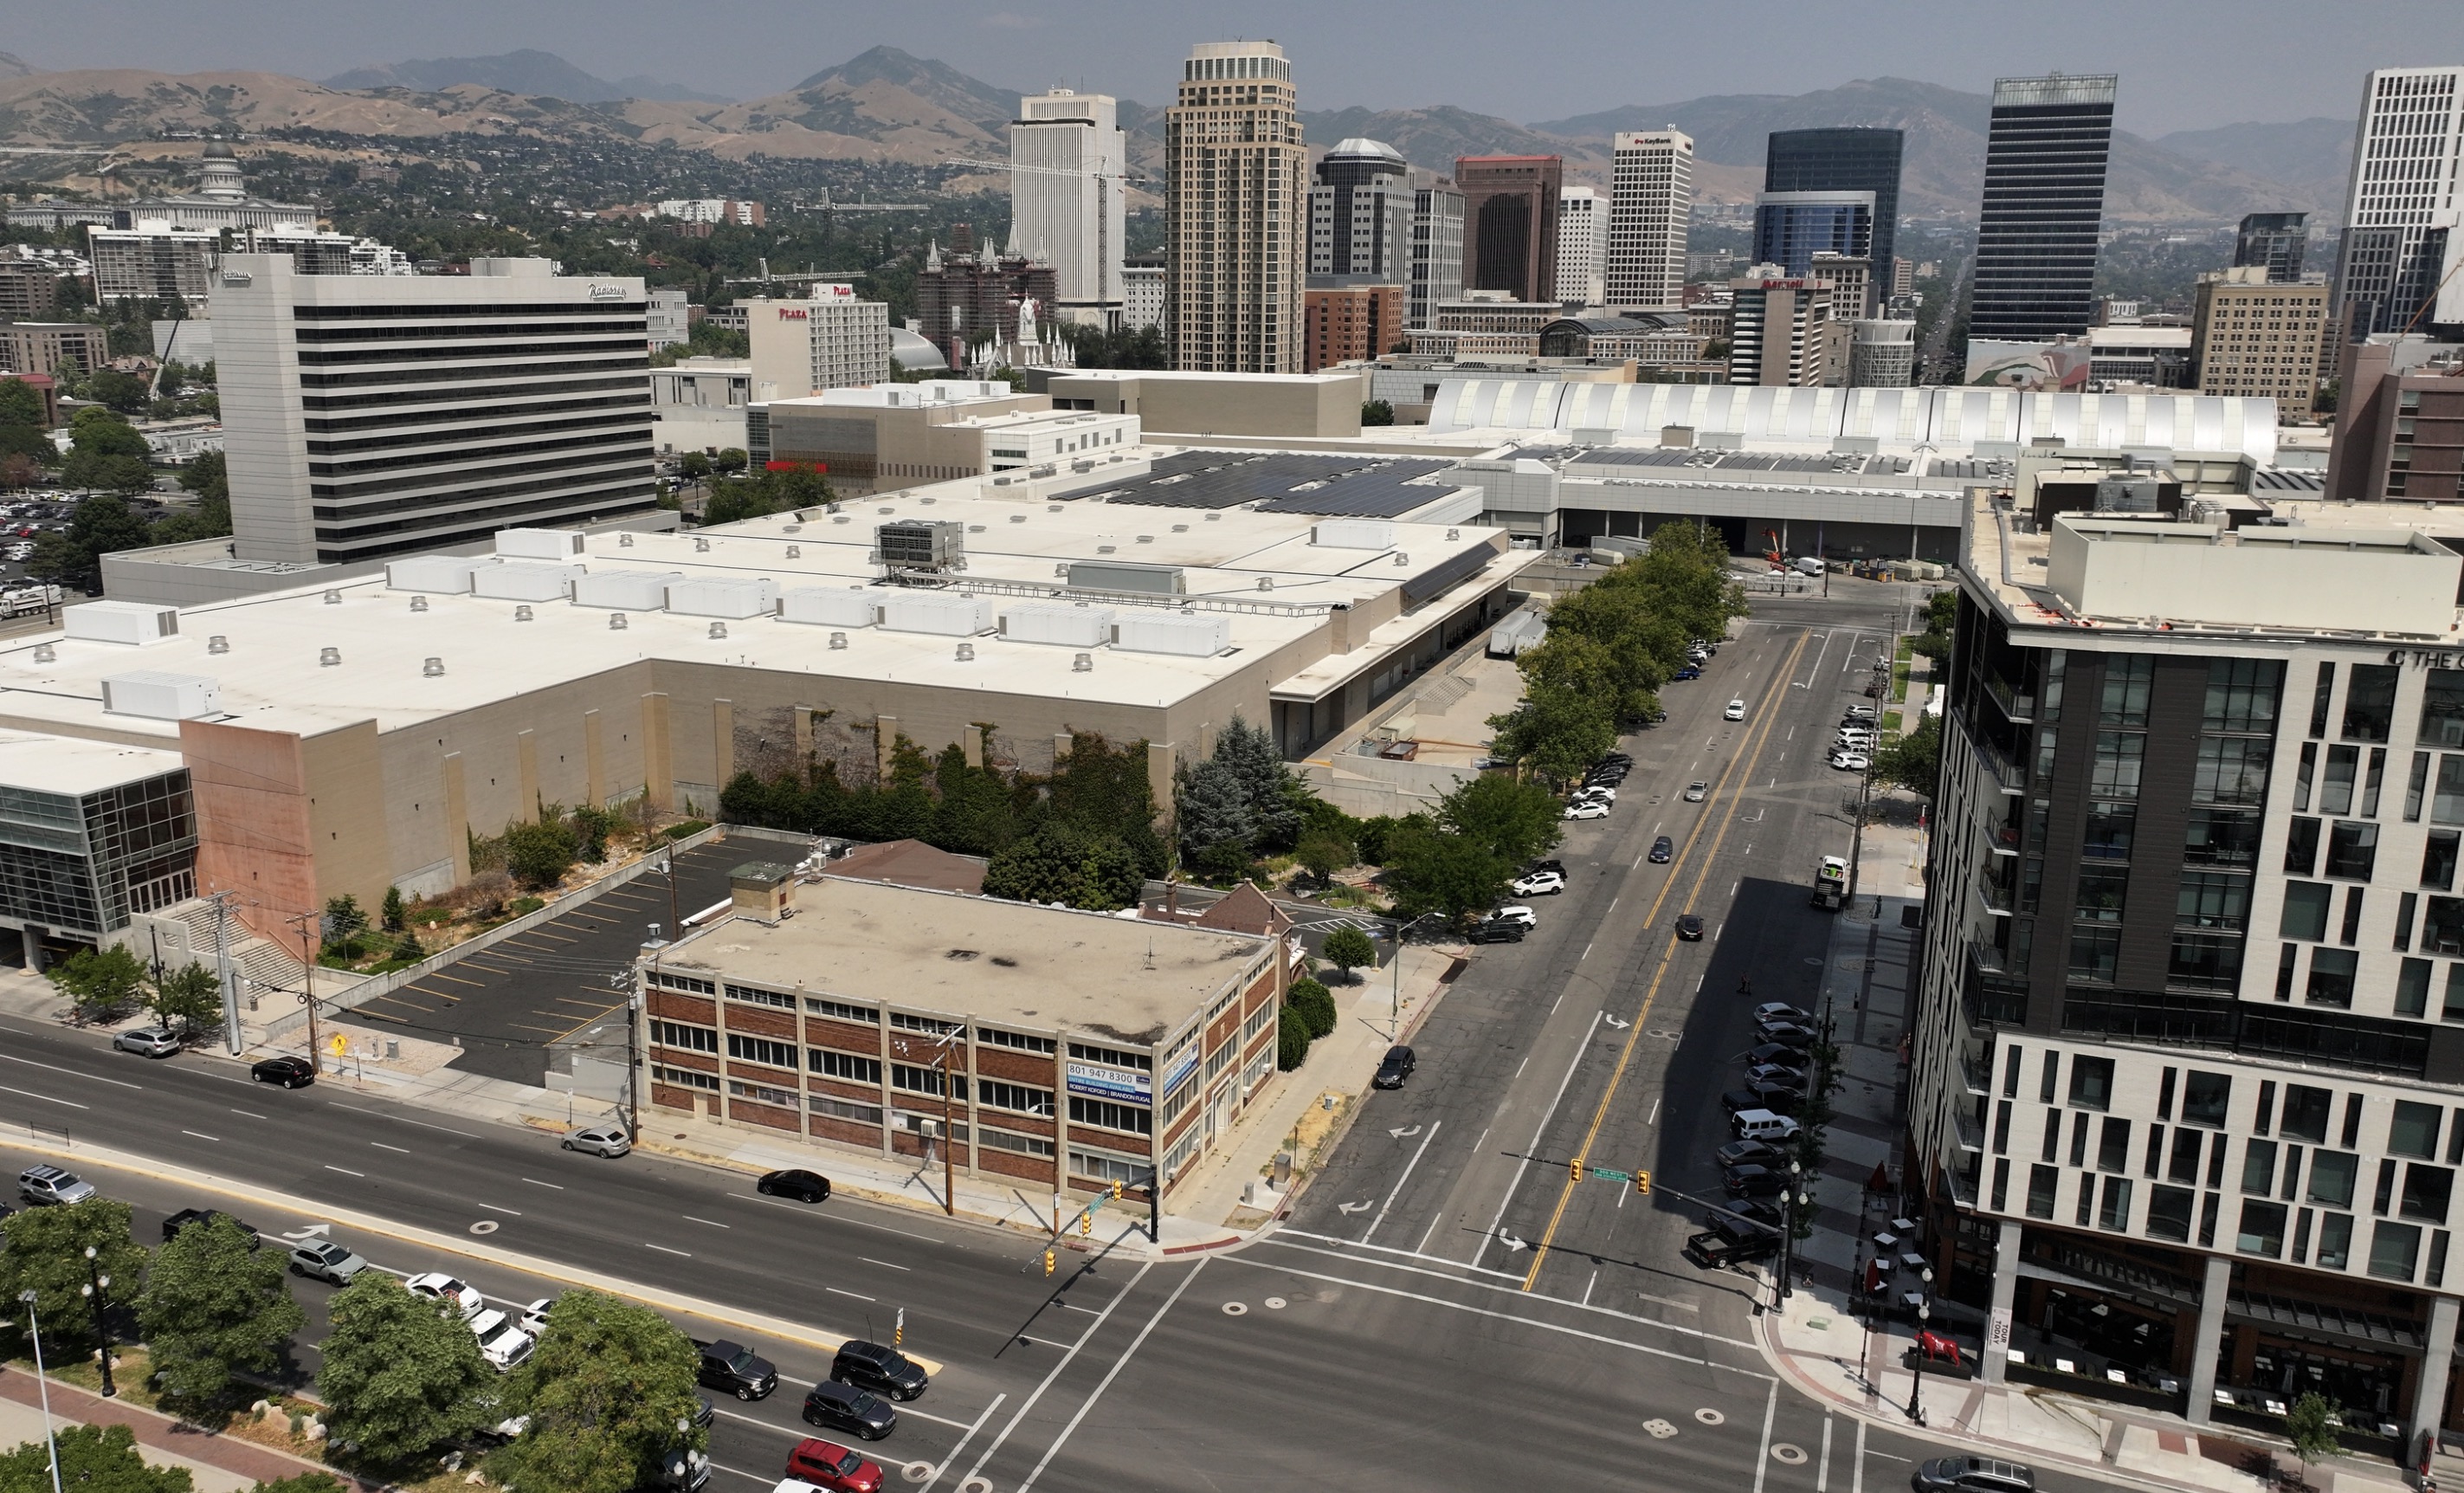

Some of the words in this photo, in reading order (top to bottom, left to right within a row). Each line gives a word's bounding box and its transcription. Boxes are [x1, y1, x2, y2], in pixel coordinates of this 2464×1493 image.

[833, 286, 851, 295] PLAZA
[1760, 279, 1803, 289] Marriott
[778, 307, 807, 320] PLAZA
[2413, 651, 2453, 668] THE
[1069, 1064, 1086, 1076] 801
[1089, 1068, 1106, 1079] 947
[1109, 1071, 1132, 1083] 8300
[1068, 1076, 1086, 1084] ENTIRE
[1086, 1079, 1108, 1089] BUILDING
[1109, 1083, 1134, 1093] AVAILABLE
[1069, 1083, 1087, 1092] ROBERT
[1110, 1090, 1135, 1101] BRANDON
[1993, 1321, 2002, 1345] TODAY
